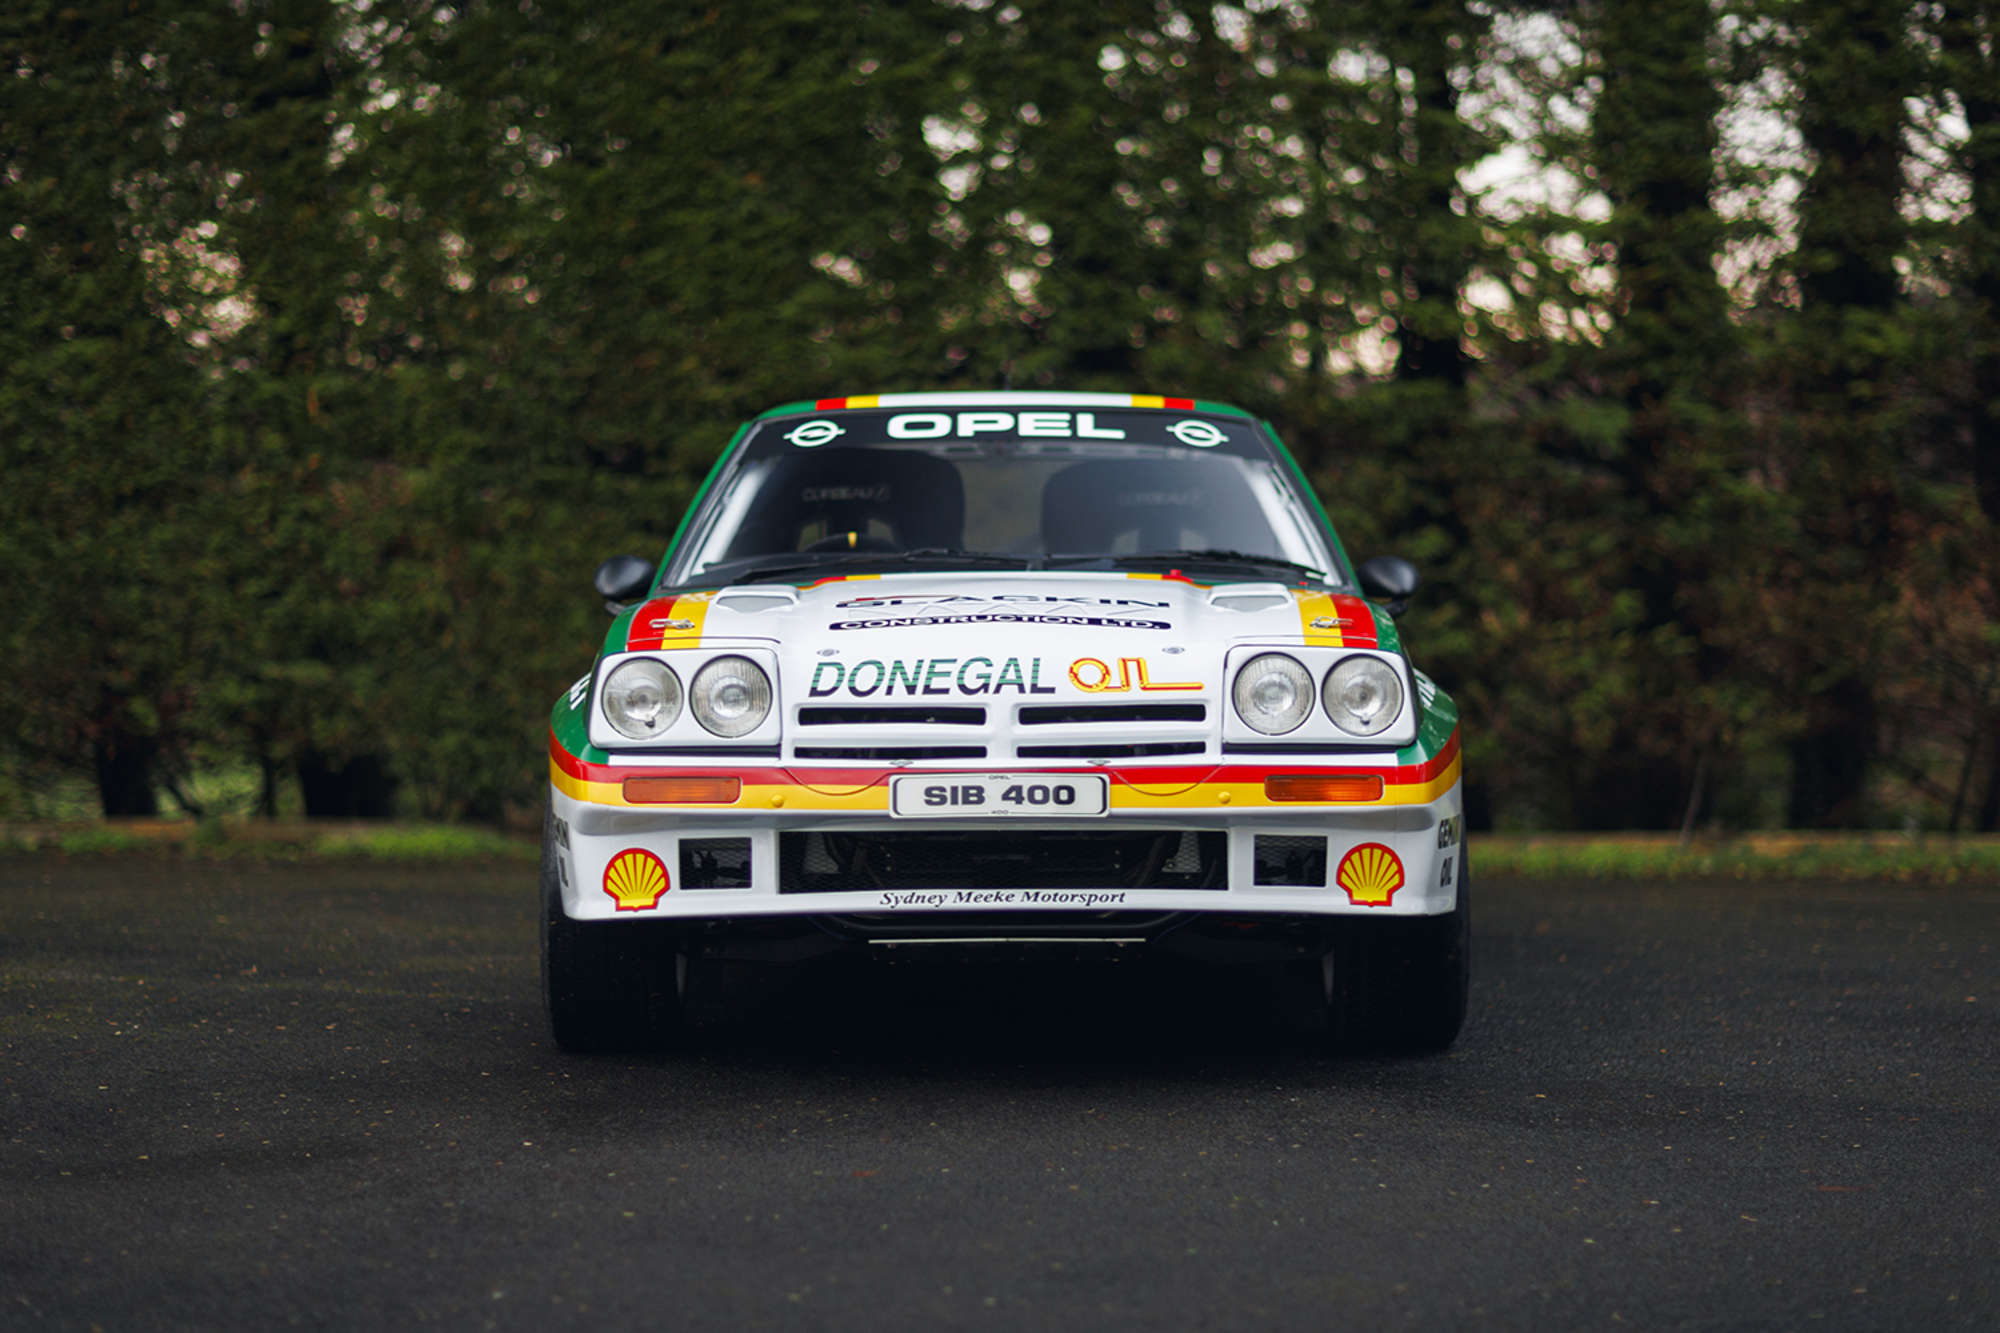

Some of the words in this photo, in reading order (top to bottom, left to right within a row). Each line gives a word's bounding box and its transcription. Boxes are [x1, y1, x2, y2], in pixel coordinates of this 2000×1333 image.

[887, 412, 1127, 440] OPEL
[840, 615, 1091, 629] CONSTRUCTION
[809, 657, 1056, 697] DONEGAL
[1069, 657, 1203, 693] OIL
[923, 785, 985, 806] SIB
[1001, 785, 1076, 806] 400
[879, 891, 948, 907] Sydney
[953, 890, 1016, 904] Meeke
[1020, 890, 1128, 905] Motorsport
